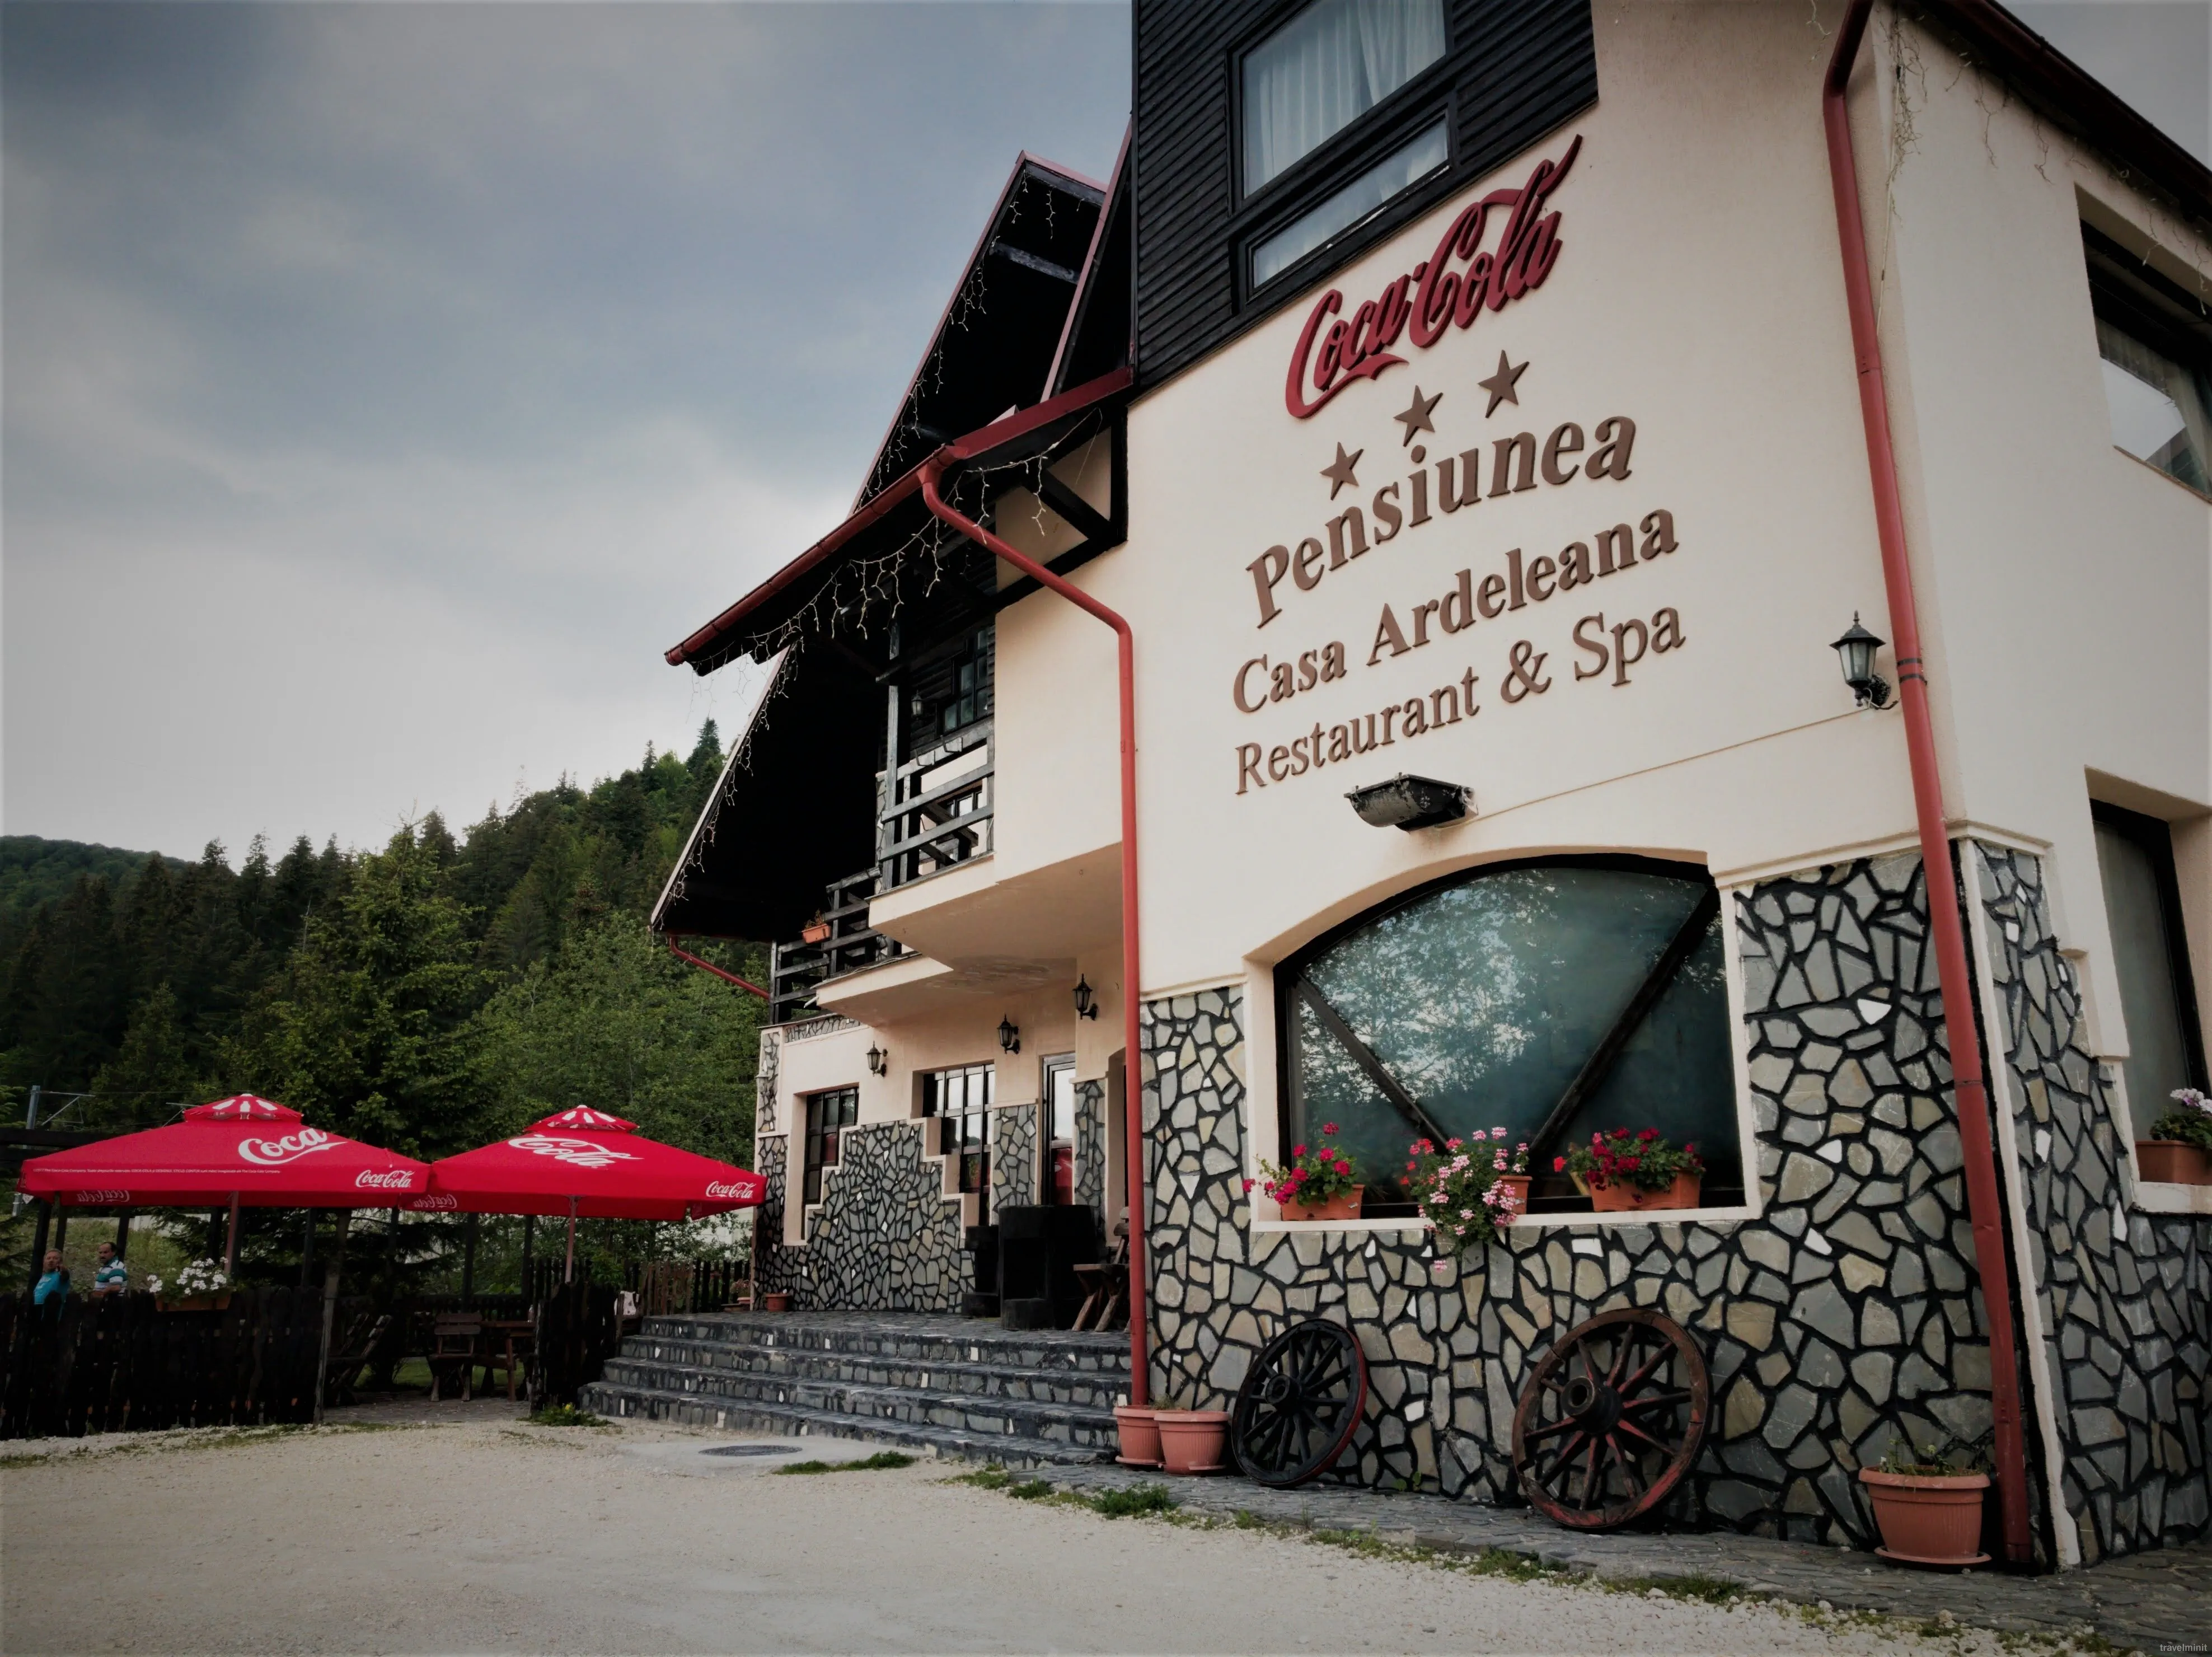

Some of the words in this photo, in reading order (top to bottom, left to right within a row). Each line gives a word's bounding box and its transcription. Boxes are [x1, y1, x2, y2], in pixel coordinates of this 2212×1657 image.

[1285, 134, 1585, 419] Coca-Cola
[1232, 639, 1347, 714] Casa
[1366, 508, 1679, 666] Ardeleana
[1246, 415, 1637, 629] Pensiunea
[1235, 666, 1480, 795] Restaurant
[1500, 638, 1553, 705] &
[1573, 606, 1686, 687] Spa
[238, 1128, 348, 1165] Coca
[355, 1169, 416, 1188] Coca-Cola
[705, 1181, 757, 1199] Coca-Cola
